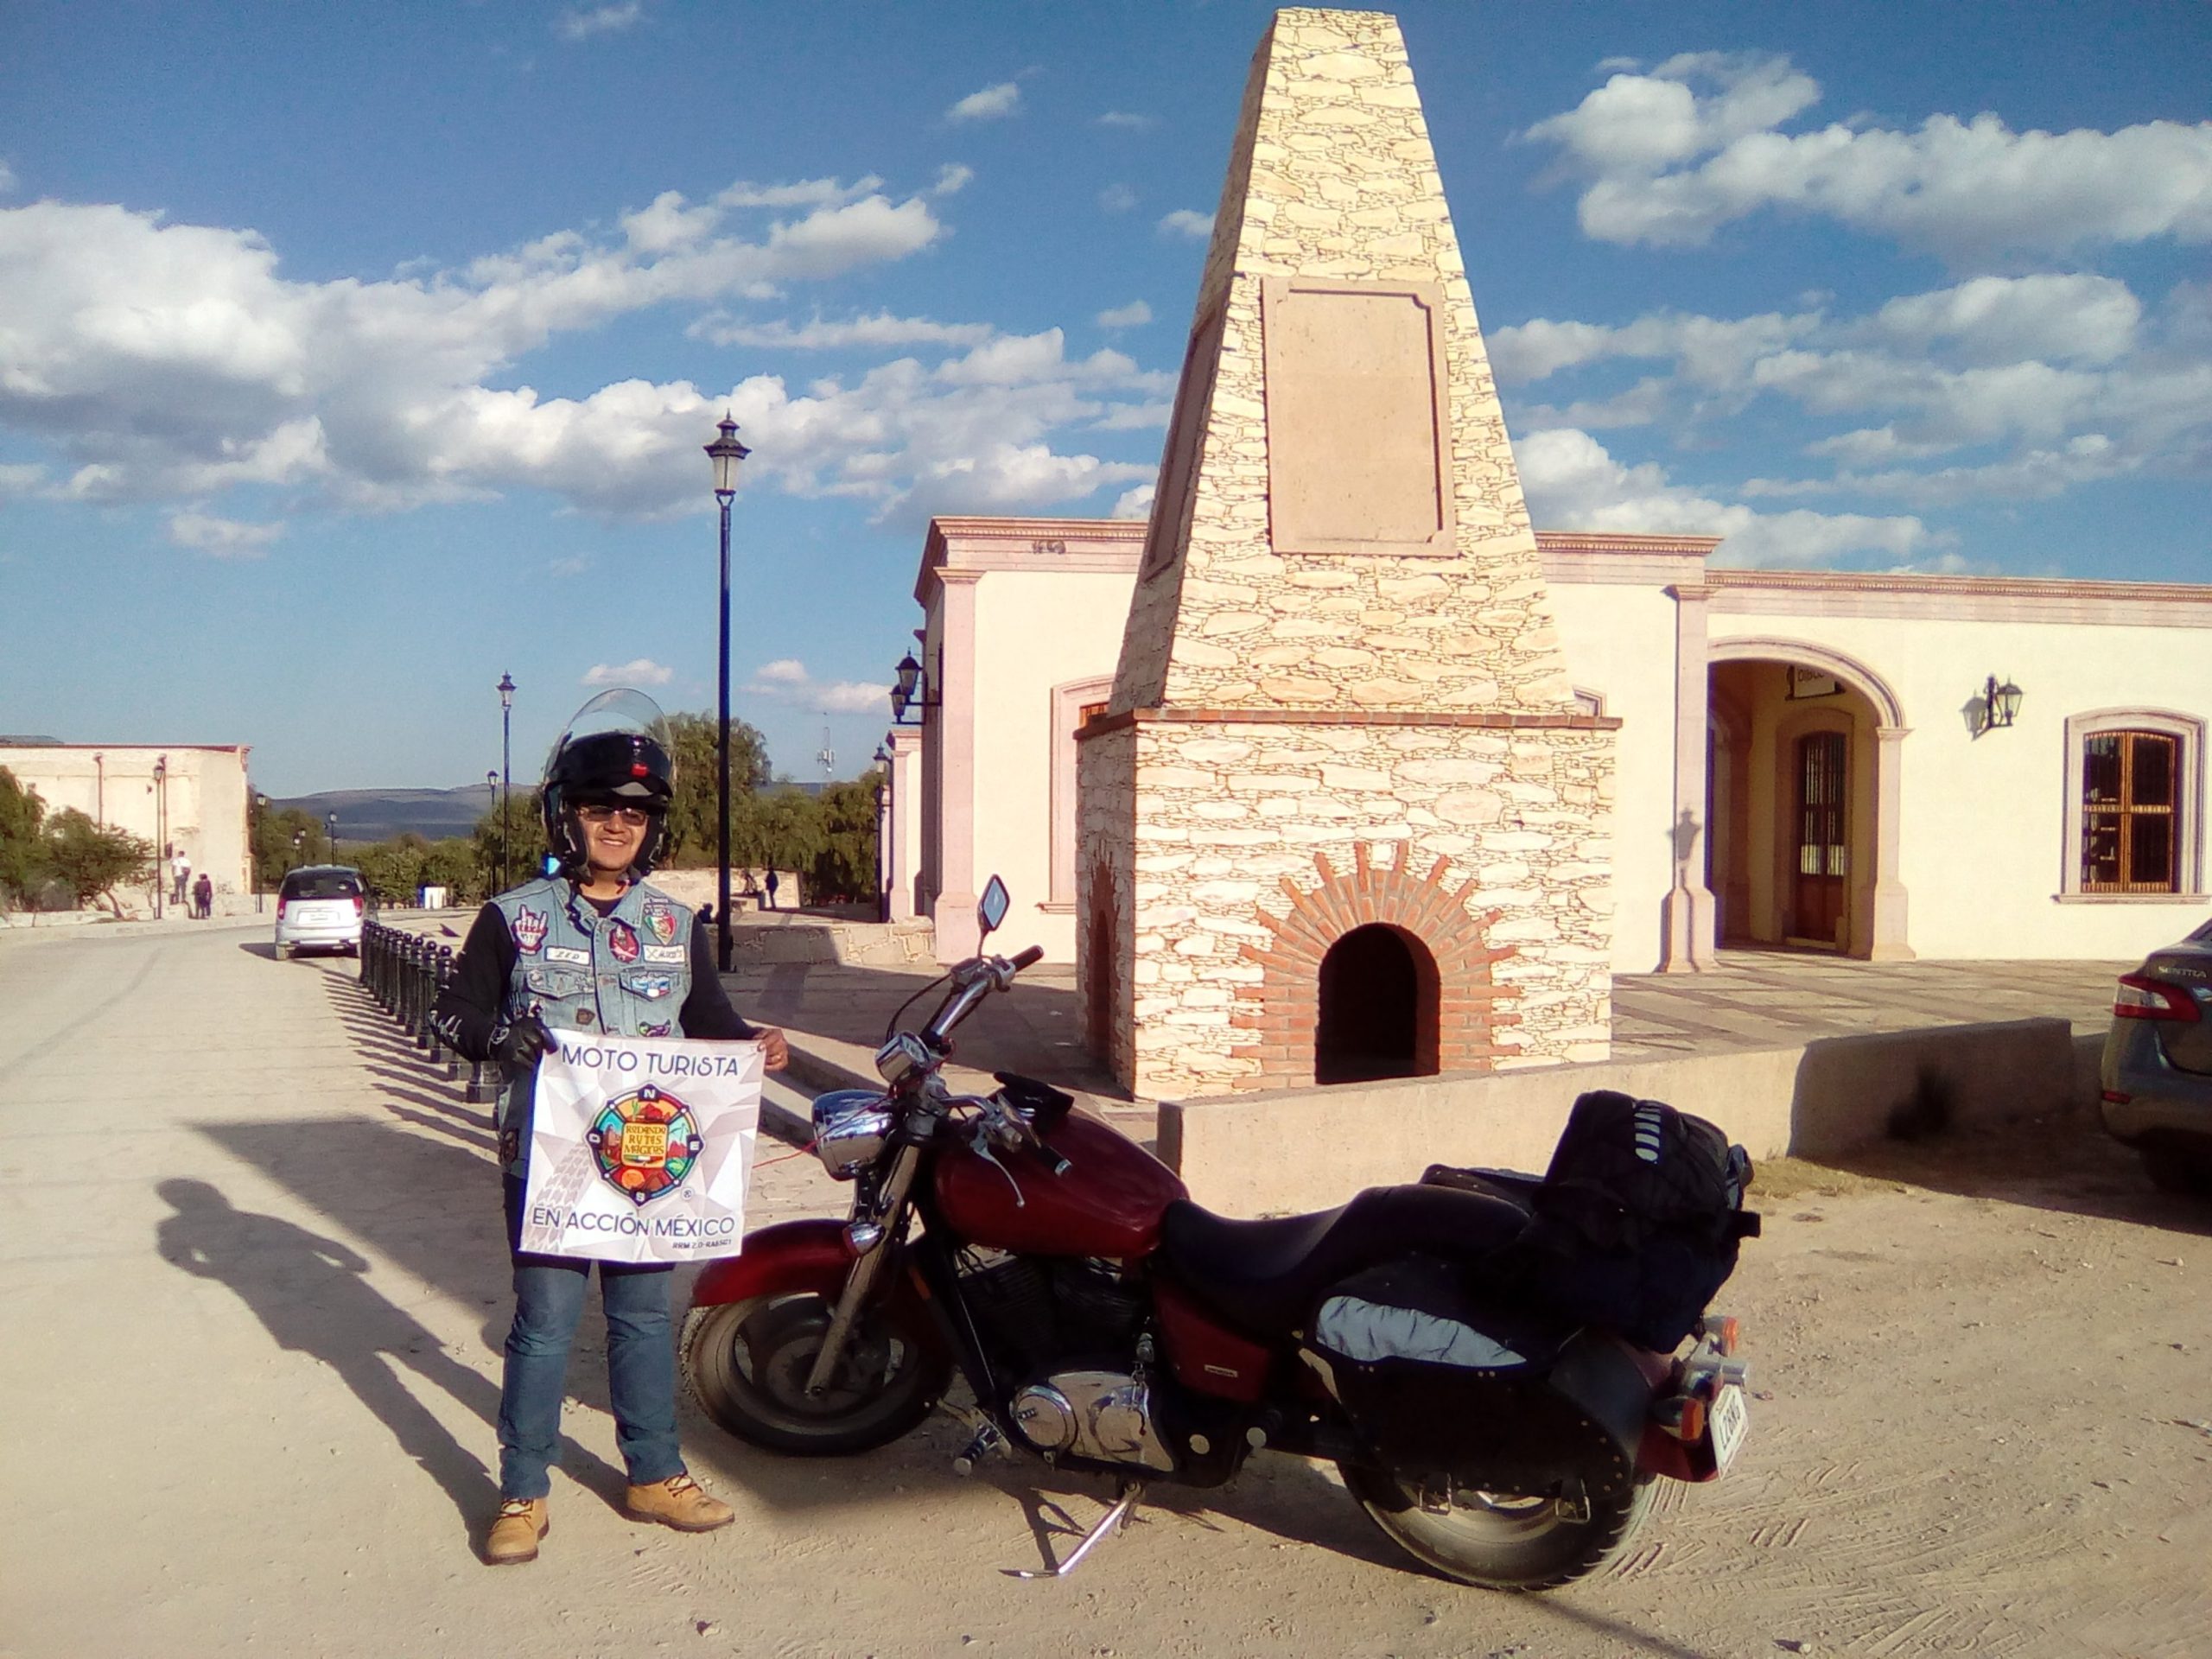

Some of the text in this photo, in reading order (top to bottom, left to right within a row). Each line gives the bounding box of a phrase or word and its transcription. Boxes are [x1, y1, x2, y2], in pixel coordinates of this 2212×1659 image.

[563, 1044, 738, 1077] MOTO TURISTA
[644, 1089, 656, 1099] N
[532, 1207, 735, 1236] EN ACCIÓN MÉXICO
